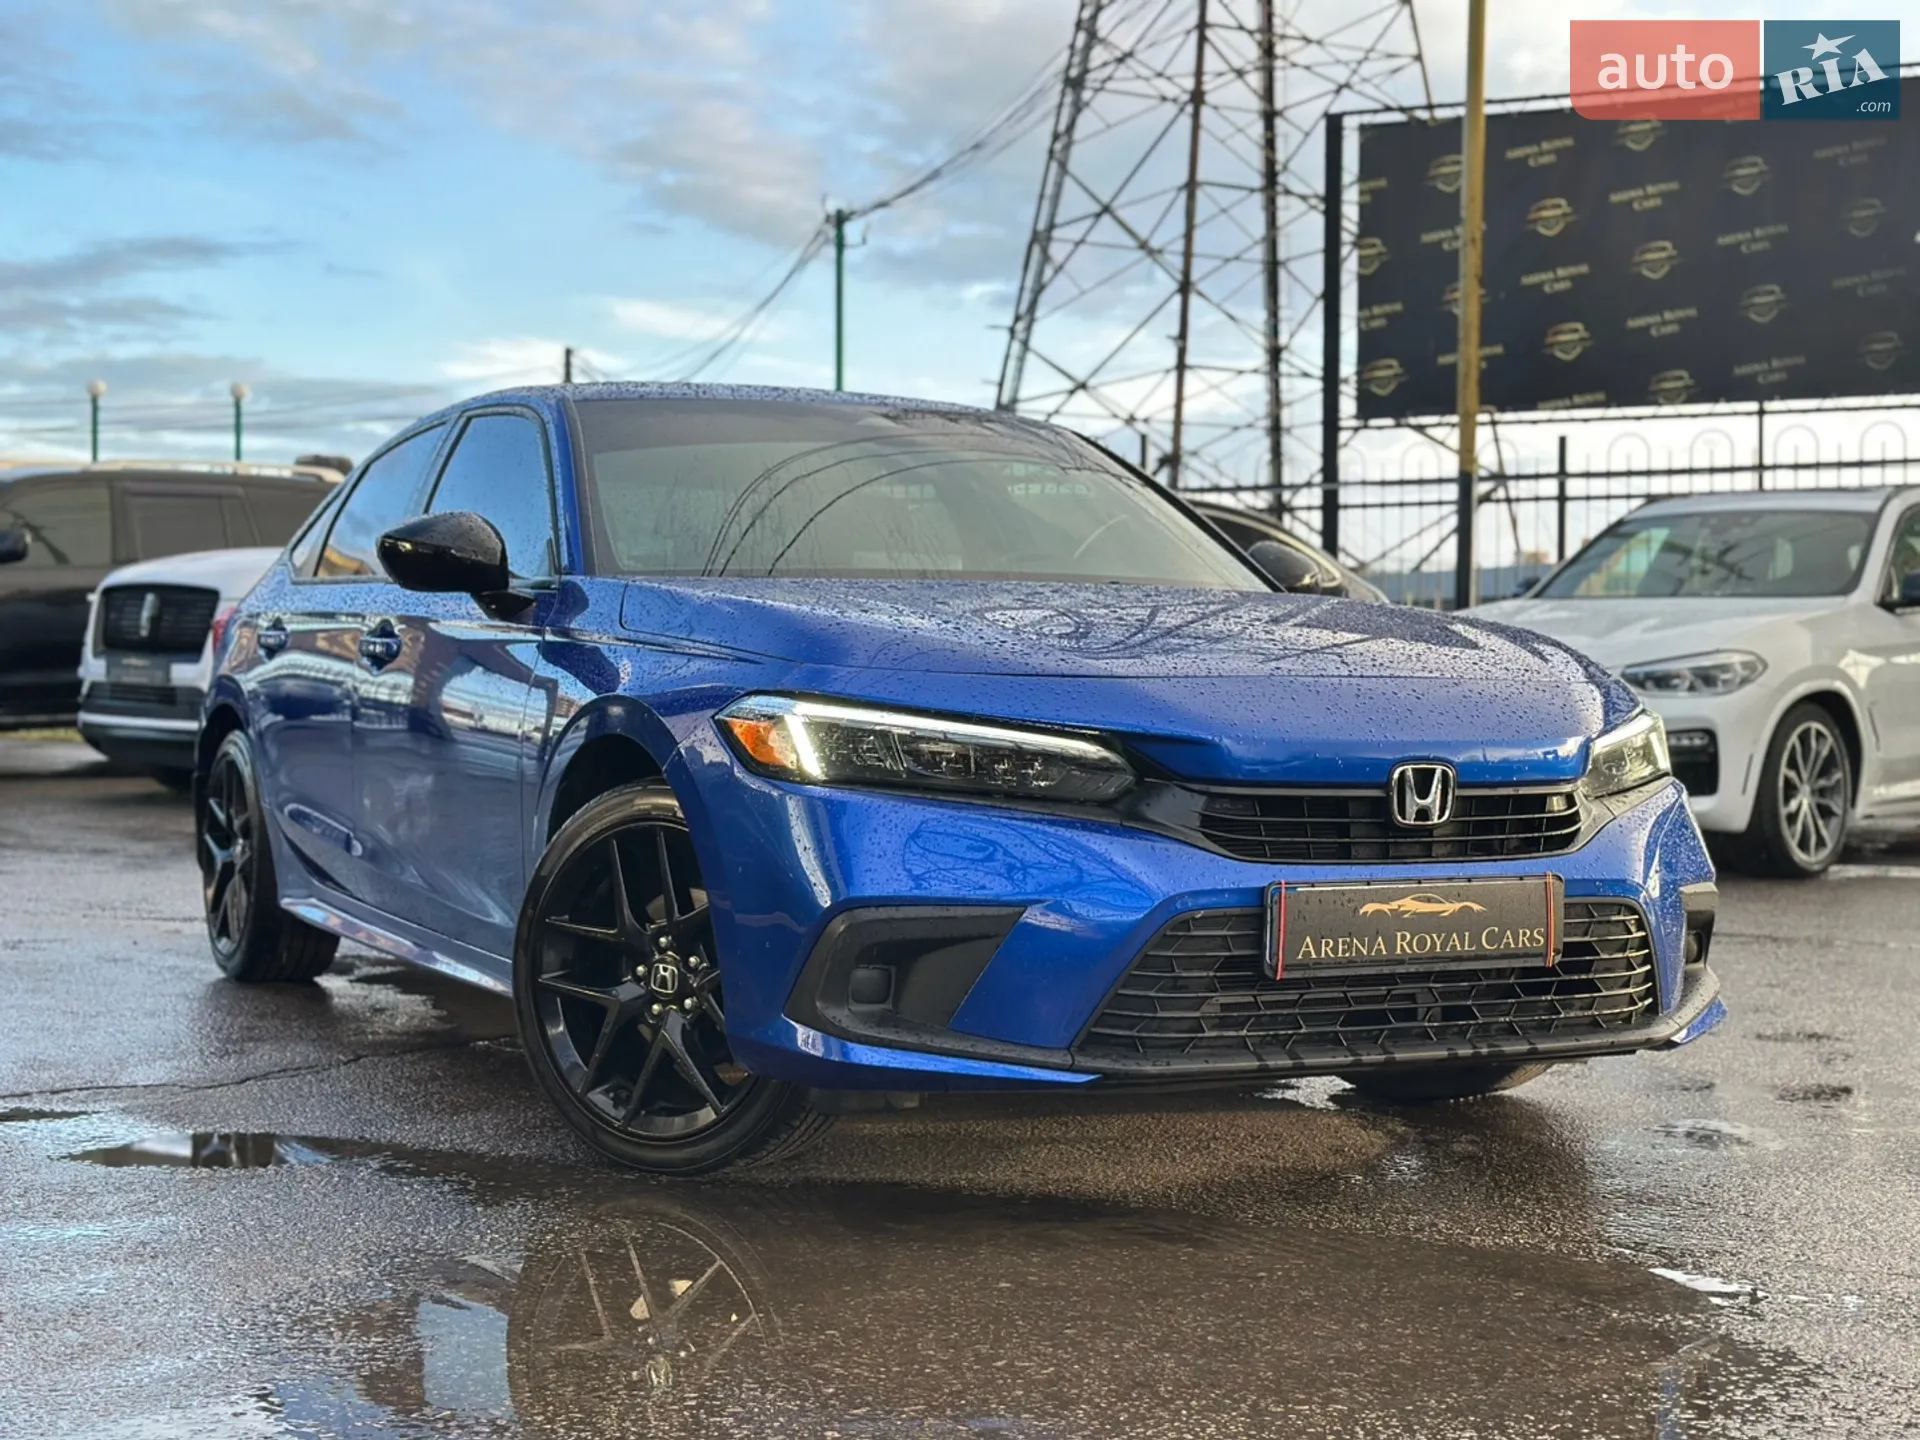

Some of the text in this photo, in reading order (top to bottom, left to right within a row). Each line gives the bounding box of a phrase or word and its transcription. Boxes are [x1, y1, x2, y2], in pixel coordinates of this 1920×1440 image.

[1296, 926, 1545, 959] ARENA ROYAL CARS
